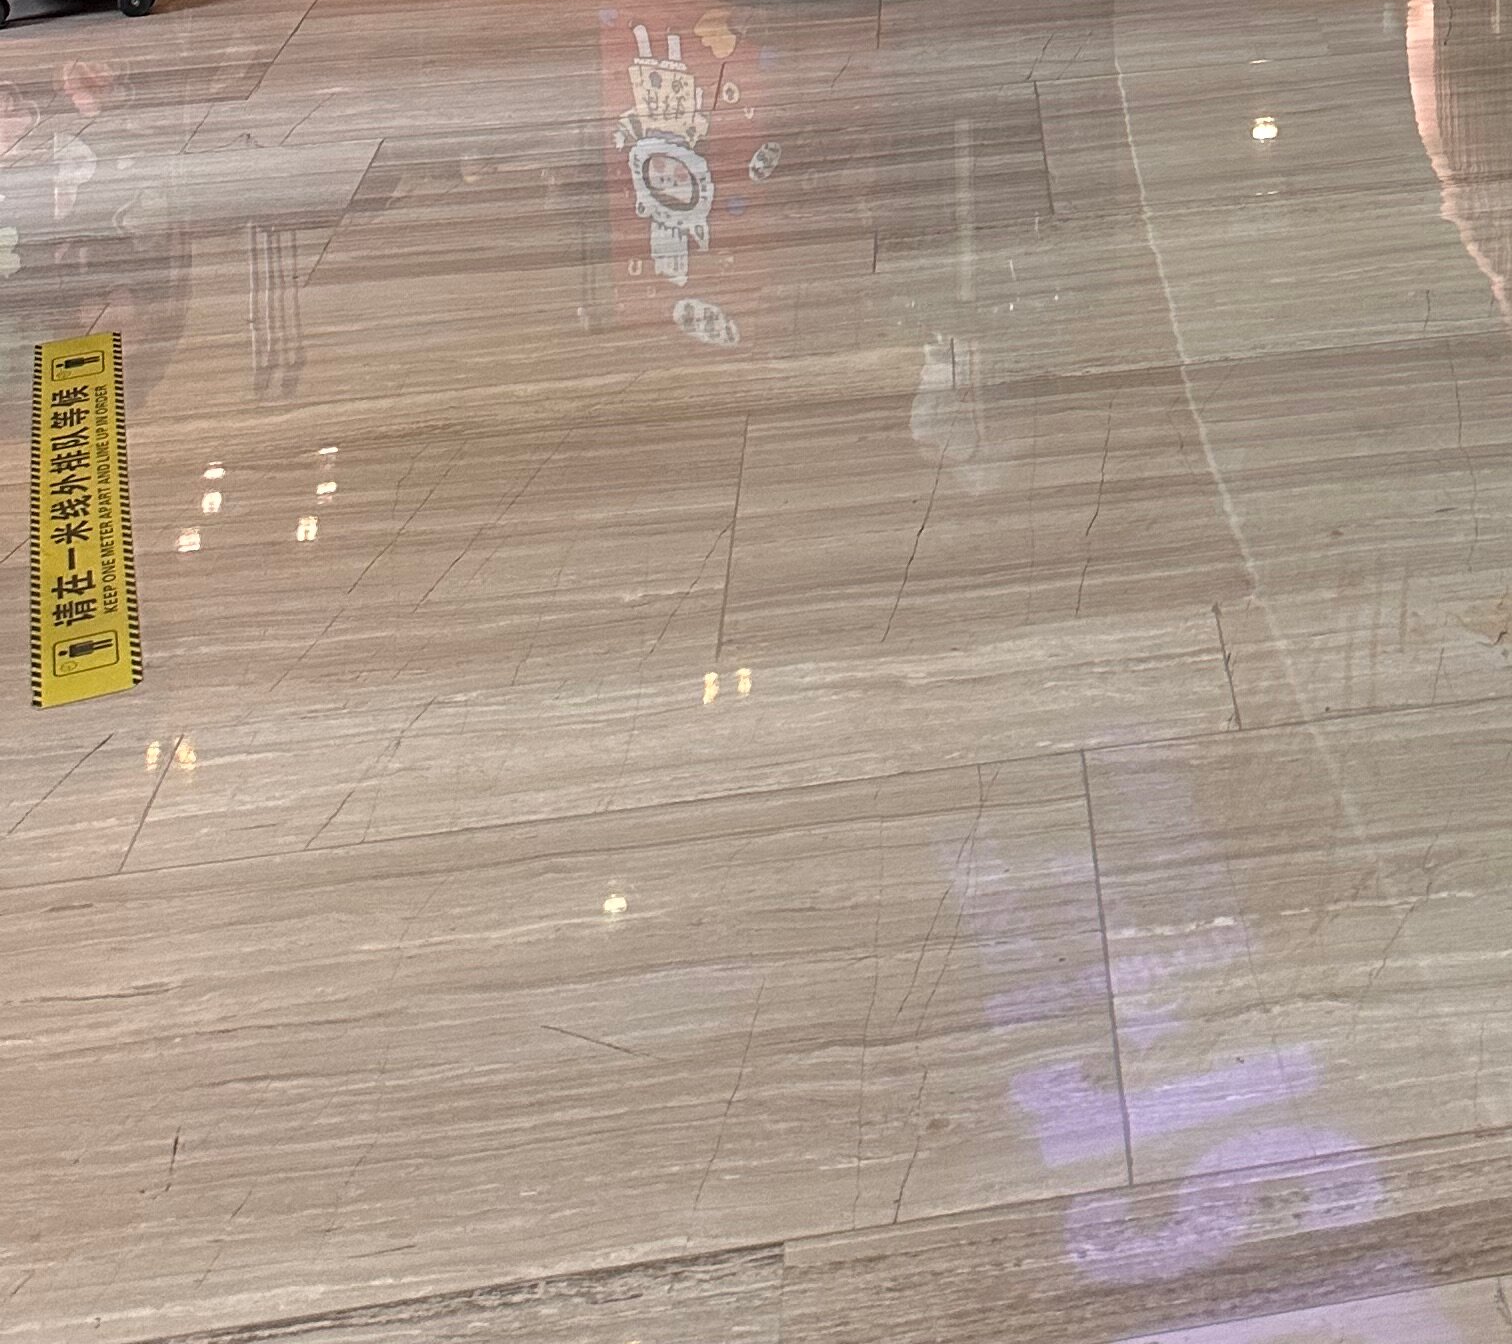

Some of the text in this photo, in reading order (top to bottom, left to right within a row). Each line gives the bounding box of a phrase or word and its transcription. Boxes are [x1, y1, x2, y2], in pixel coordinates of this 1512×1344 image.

[50, 384, 97, 627] 请在一米线外排队等候
[94, 384, 118, 614] KEEP ONE METER APART AND LINE UP IN ORDER
